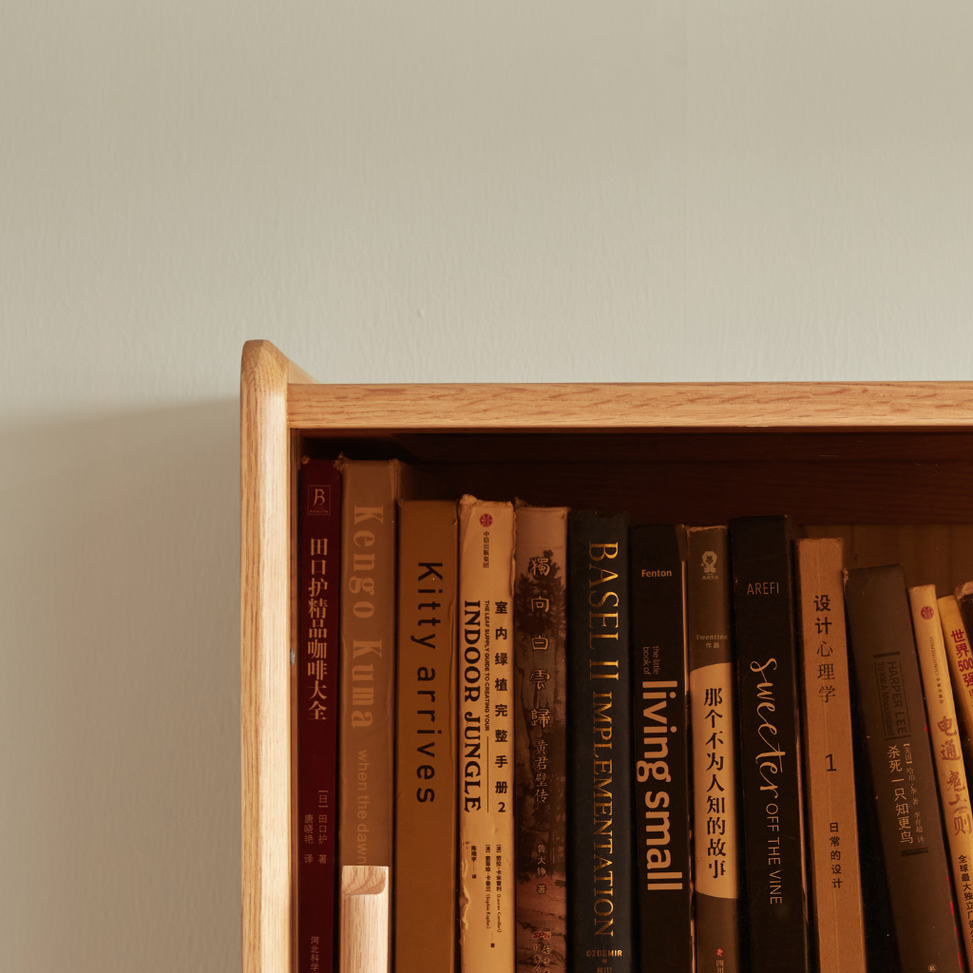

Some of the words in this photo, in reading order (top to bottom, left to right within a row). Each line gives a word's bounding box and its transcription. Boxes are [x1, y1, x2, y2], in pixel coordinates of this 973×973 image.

[350, 505, 384, 619] Kengo
[641, 569, 672, 578] Fenton
[410, 562, 443, 649] Kitty
[588, 541, 619, 650] BASEL
[747, 582, 779, 596] AREFI
[307, 538, 328, 721] 田口护精品咖啡大全
[464, 601, 481, 702] INDOOR
[814, 594, 836, 703] 设计心理学
[589, 659, 619, 681] II
[643, 647, 651, 664] book
[643, 665, 651, 675] of
[652, 646, 660, 659] the
[652, 661, 660, 675] little
[877, 662, 885, 671] To
[351, 639, 383, 729] Kuma
[484, 672, 490, 681] TO
[879, 672, 887, 684] Kill
[888, 661, 903, 708] HARPER
[416, 666, 442, 803] arrives
[636, 680, 678, 783] living
[881, 692, 895, 736] Mockingbird
[895, 712, 907, 735] LEE
[357, 750, 370, 790] when
[464, 711, 481, 812] JUNGLE
[533, 739, 549, 804] 黄君璧传
[704, 688, 726, 878] 那个不为人知的故事
[825, 753, 837, 772] 1
[357, 794, 370, 818] the
[592, 691, 614, 938] IMPLEMENTATION
[887, 744, 913, 844] 杀死一只知更鸟
[765, 803, 779, 832] OFF
[357, 821, 370, 866] dawn
[645, 791, 684, 891] small
[767, 837, 781, 866] THE
[829, 822, 842, 889] 日常的设计
[769, 869, 782, 905] VINE
